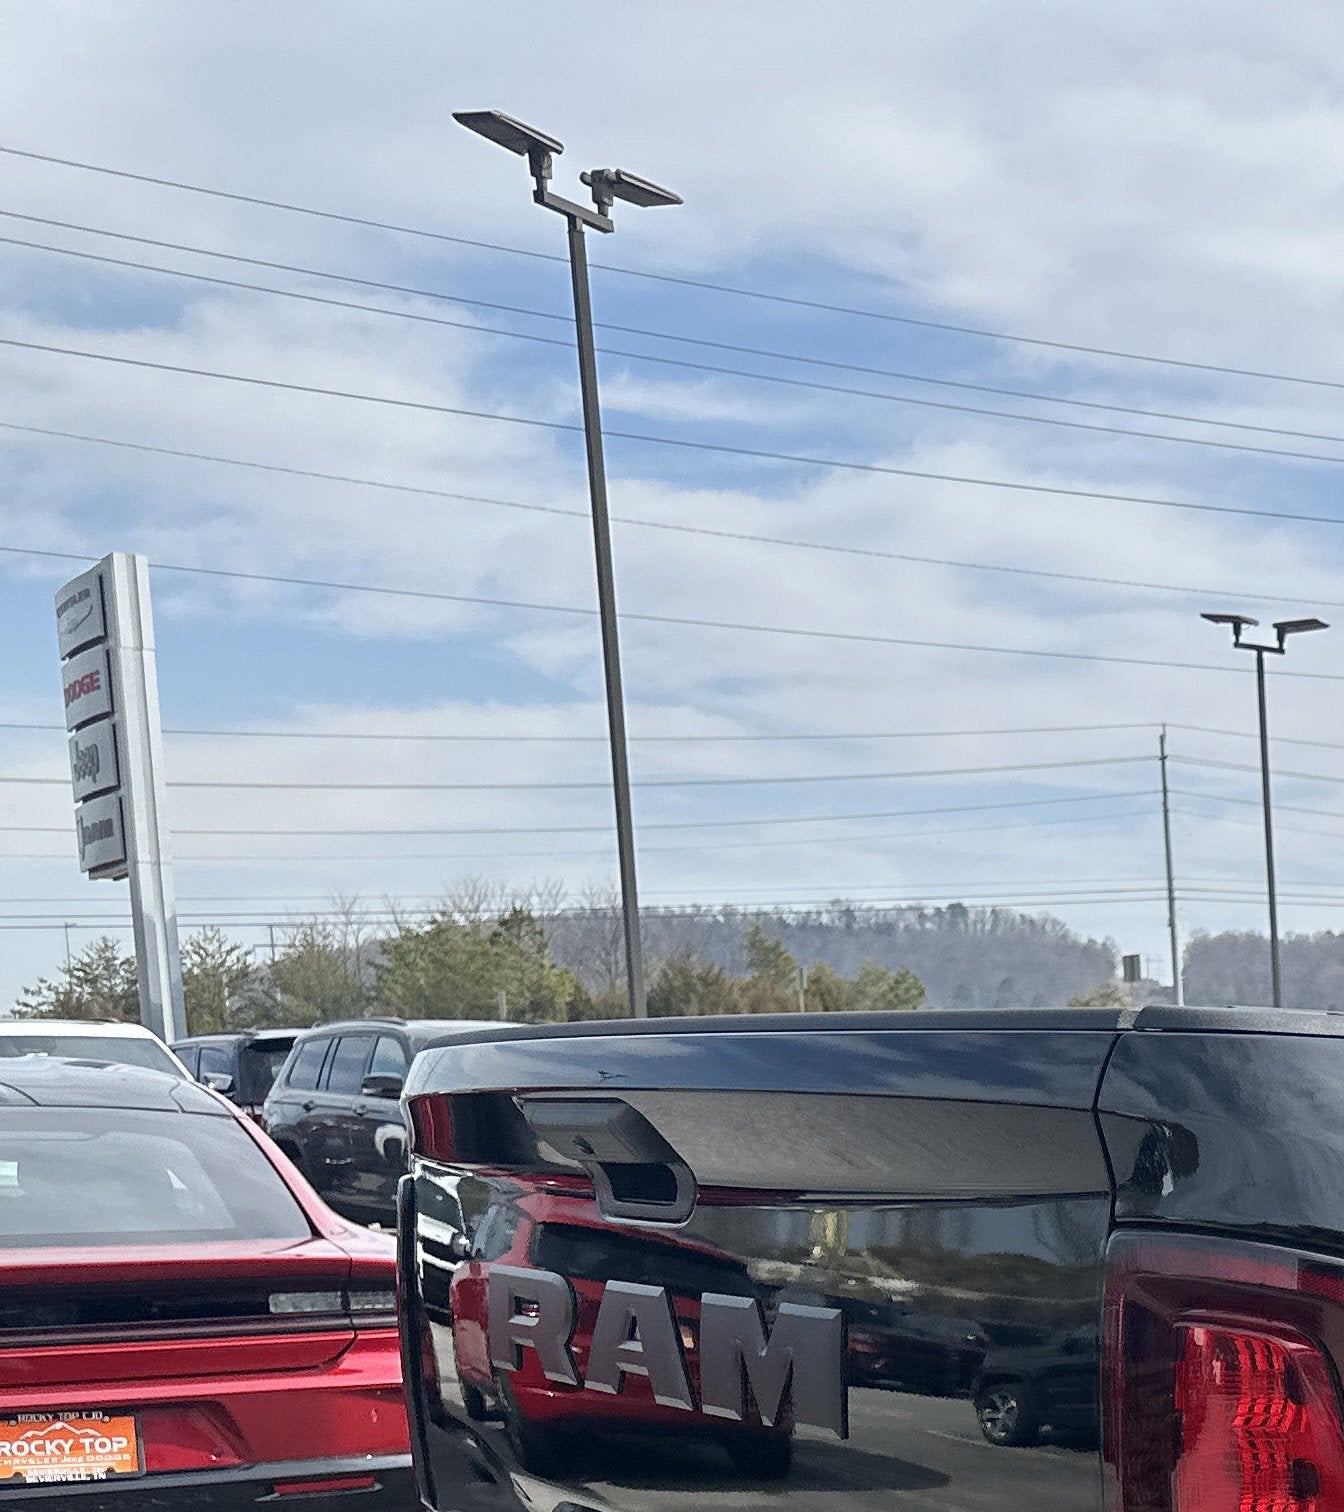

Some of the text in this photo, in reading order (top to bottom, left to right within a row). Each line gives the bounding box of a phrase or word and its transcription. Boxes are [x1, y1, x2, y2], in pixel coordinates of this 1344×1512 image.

[487, 1263, 849, 1440] RAM
[0, 1437, 128, 1457] ROCKY TOP
[0, 1457, 58, 1466] HRYSLER
